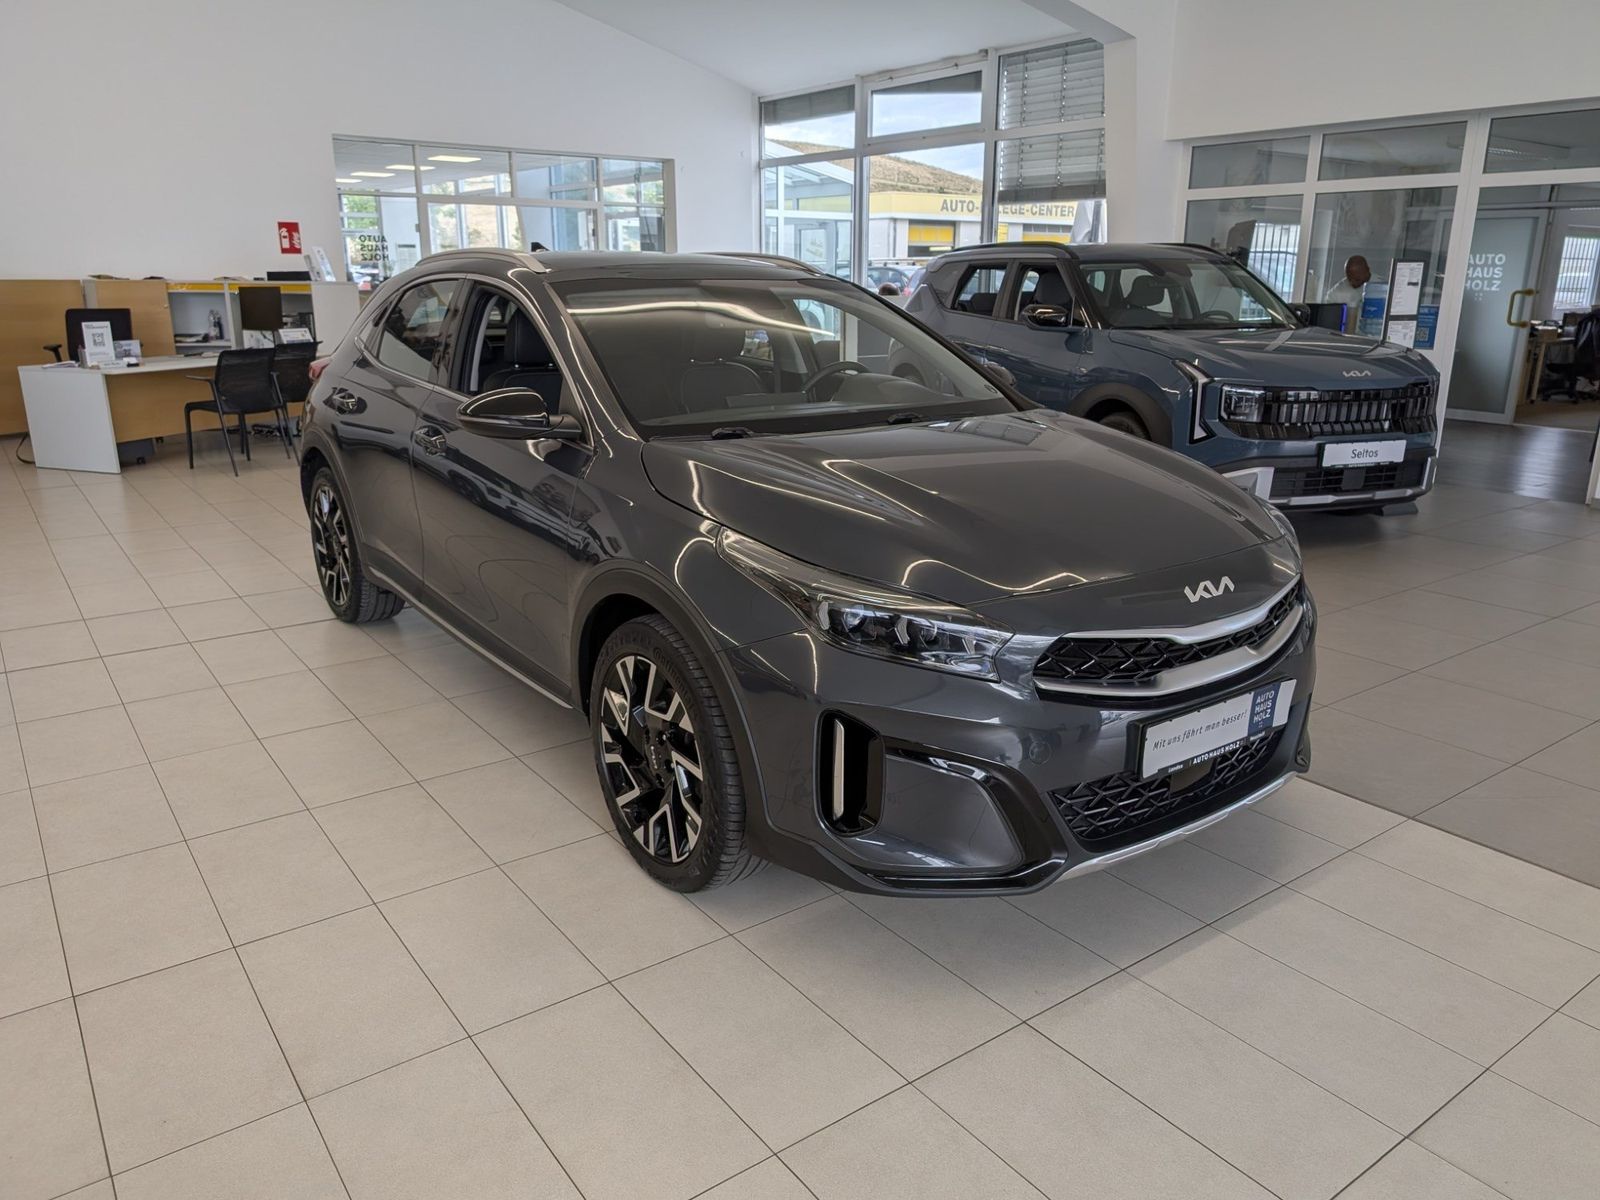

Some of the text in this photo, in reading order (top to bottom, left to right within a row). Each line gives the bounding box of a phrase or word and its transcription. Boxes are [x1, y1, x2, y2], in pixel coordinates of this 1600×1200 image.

[940, 199, 1075, 217] AUTO-EGE-CENTER
[1342, 370, 1371, 378] KIA
[1351, 448, 1378, 459] Seltos
[1184, 575, 1235, 603] KIA
[1255, 690, 1274, 704] AUTO
[1254, 700, 1272, 714] HAUS
[1253, 709, 1271, 724] HOLZ
[1153, 709, 1248, 751] Mit uns fährt man besser!
